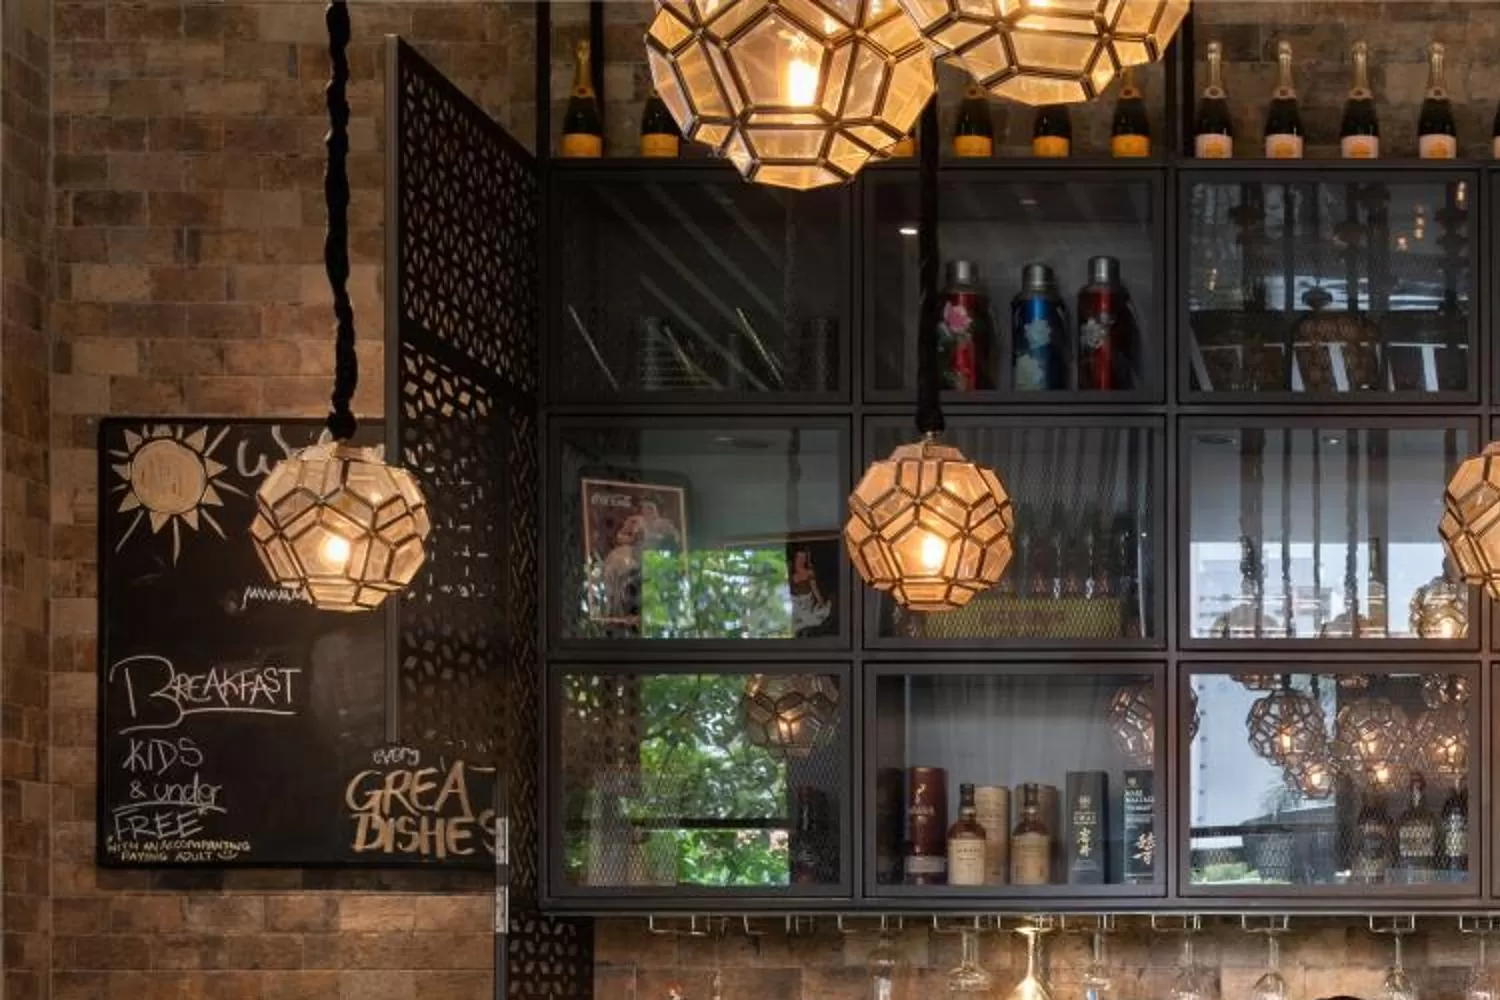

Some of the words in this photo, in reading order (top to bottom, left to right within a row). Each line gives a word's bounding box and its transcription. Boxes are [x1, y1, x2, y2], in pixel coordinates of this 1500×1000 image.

[109, 655, 302, 734] BREAKFAST
[122, 737, 203, 776] KIDS
[154, 771, 223, 806] under
[346, 760, 496, 818] GREA
